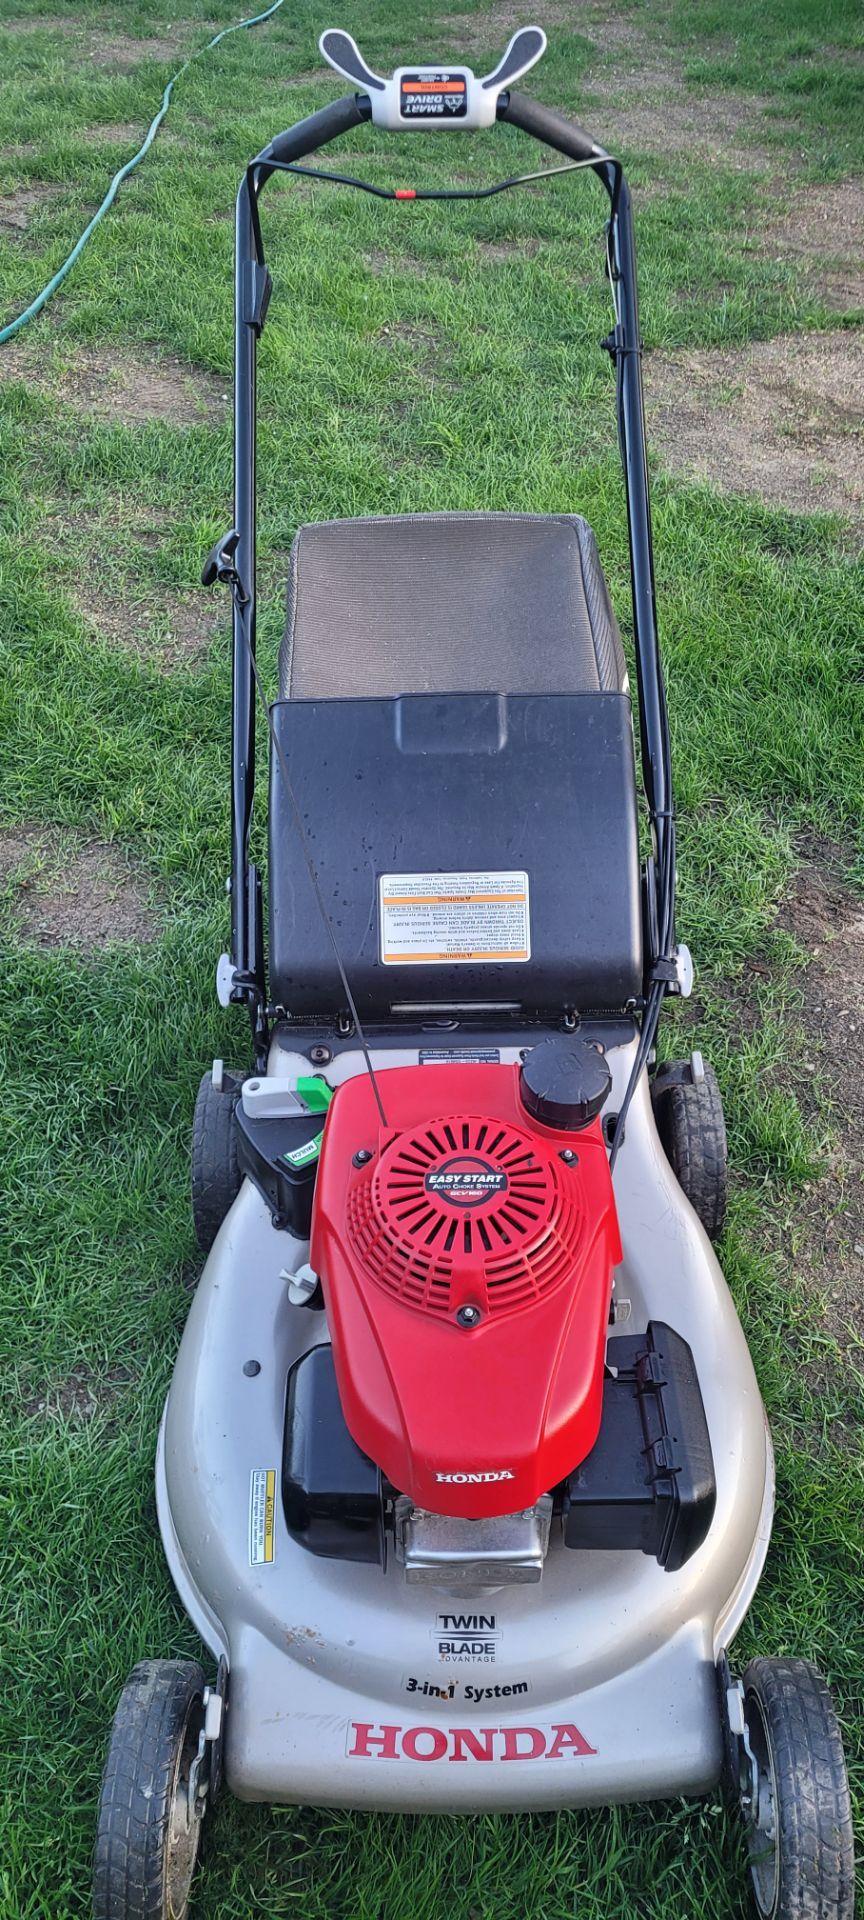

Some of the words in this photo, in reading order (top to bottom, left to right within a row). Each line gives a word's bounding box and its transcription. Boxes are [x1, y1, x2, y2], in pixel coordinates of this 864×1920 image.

[406, 95, 443, 104] DRIVE
[404, 105, 444, 113] SMART
[291, 1145, 314, 1159] MULCH
[428, 1174, 462, 1183] EASY
[462, 1174, 503, 1183] START
[435, 1470, 515, 1484] HONDA
[265, 1504, 273, 1536] CAUTION
[438, 1615, 495, 1629] TWIN
[438, 1642, 495, 1655] BLADE
[406, 1678, 455, 1698] 3-in-1
[464, 1682, 528, 1702] System
[349, 1723, 598, 1761] HONDA
